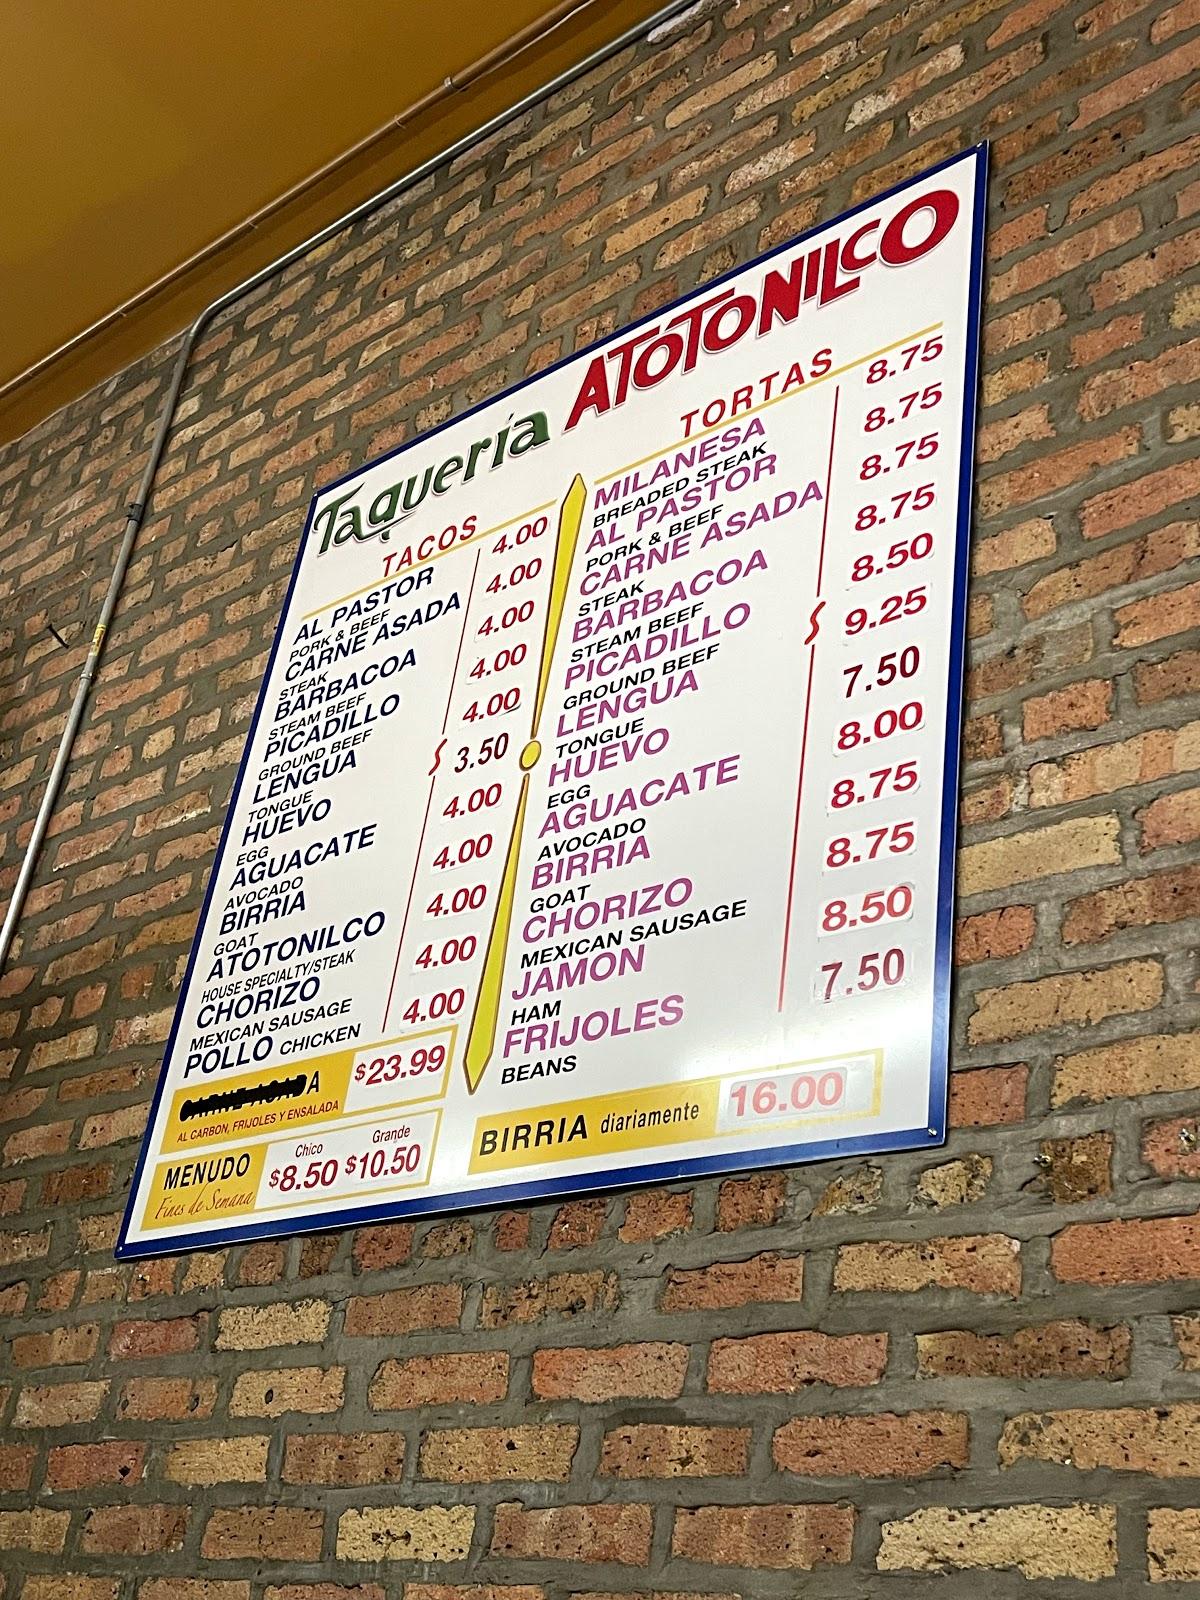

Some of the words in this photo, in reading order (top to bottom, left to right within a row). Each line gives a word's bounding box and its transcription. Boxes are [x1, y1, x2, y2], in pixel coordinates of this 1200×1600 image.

[563, 187, 962, 433] ATOTONILCO
[866, 335, 943, 384] 8.75
[681, 348, 833, 437] TORTAS
[863, 382, 943, 432] 8.75
[594, 418, 766, 510] MILANESA
[859, 432, 939, 480] 8.75
[585, 527, 625, 554] AL
[636, 454, 778, 532] PASTOR
[593, 478, 689, 528] BREADED
[696, 442, 767, 482] STEAK
[854, 483, 935, 531] 8.75
[383, 515, 477, 577] TACOS
[492, 515, 548, 554] 4.00
[579, 534, 691, 596] CARNE
[700, 481, 823, 549] ASADA
[586, 540, 642, 572] PORK
[648, 532, 661, 546] &
[669, 505, 724, 534] BEEF
[851, 532, 933, 582] 8.50
[485, 558, 542, 595] 4.00
[572, 549, 768, 643] BARBACOA
[578, 580, 645, 617] STEAK
[293, 623, 326, 645] AL
[330, 566, 435, 626] PASTOR
[477, 600, 535, 637] 4.00
[845, 586, 927, 635] 9.25
[285, 638, 367, 683] CARNE
[372, 592, 461, 647] ASADA
[289, 638, 332, 662] PORK
[336, 628, 347, 642] &
[350, 609, 390, 634] BEEF
[564, 602, 751, 690] PICADILLO
[571, 627, 642, 662] STEAM
[648, 602, 704, 634] BEEF
[274, 648, 418, 723] BARBACOA
[469, 643, 528, 680] 4.00
[563, 668, 655, 710] GROUND
[662, 644, 720, 673] BEEF
[843, 645, 919, 698] 7.50
[279, 672, 329, 702] STEAK
[462, 687, 520, 724] 4.00
[556, 670, 699, 738] LENGUA
[264, 693, 400, 762] PICADILLO
[268, 711, 322, 741] STEAM
[325, 693, 367, 720] BEEF
[556, 718, 645, 758] TONGUE
[837, 700, 923, 751] 8.00
[253, 750, 357, 804] LENGUA
[258, 746, 327, 782] GROUND
[330, 730, 372, 753] BEEF
[454, 732, 510, 773] 3.50
[548, 728, 669, 787] HUEVO
[248, 791, 313, 823] TONGUE
[442, 782, 502, 819] 4.00
[537, 755, 740, 839] AGUACATE
[547, 784, 591, 809] EGG
[831, 761, 918, 809] 8.75
[242, 798, 332, 846] HUEVO
[537, 818, 647, 861] AVOCADO
[826, 822, 915, 869] 8.75
[229, 823, 378, 891] AGUACATE
[236, 846, 269, 867] EGG
[433, 833, 492, 869] 4.00
[531, 835, 650, 892] BIRRIA
[219, 891, 306, 936] BIRRIA
[224, 877, 304, 912] AVOCADO
[426, 884, 487, 918] 4.00
[521, 877, 694, 944] CHORIZO
[529, 884, 591, 914] GOAT
[821, 886, 912, 931] 8.50
[206, 910, 386, 982] ATOTONILCO
[213, 933, 259, 957] GOAT
[415, 935, 476, 969] 4.00
[520, 931, 622, 969] MEXICAN
[629, 900, 747, 943] SAUSAGE
[201, 980, 247, 1004] HOUSE
[244, 949, 356, 993] SPECIALTY/STEAK
[511, 945, 646, 1001] JAMON
[821, 948, 905, 1000] 7.50
[190, 1021, 265, 1052] MEXICAN
[269, 998, 353, 1031] SAUSAGE
[196, 976, 321, 1030] CHORIZO
[403, 988, 465, 1024] 4.00
[502, 994, 685, 1059] FRIJOLES
[511, 1000, 562, 1026] HAM
[183, 1036, 273, 1079] POLLO
[280, 1023, 361, 1056] CHICKEN
[354, 1045, 446, 1087] $23.99
[501, 1055, 577, 1085] BEANS
[731, 1071, 844, 1118] 16.00
[177, 1132, 188, 1143] AL
[190, 1124, 230, 1140] CARBON,
[232, 1113, 276, 1132] FRIJOLES
[279, 1110, 286, 1121] Y
[288, 1100, 339, 1119] ENSALADA
[372, 1125, 410, 1145] Grande
[479, 1116, 588, 1156] BIRRIA
[600, 1102, 699, 1135] diariamente
[163, 1153, 251, 1191] MENUDO
[295, 1142, 324, 1158] Chico
[344, 1144, 421, 1179] $10.50
[269, 1161, 339, 1193] $8.50
